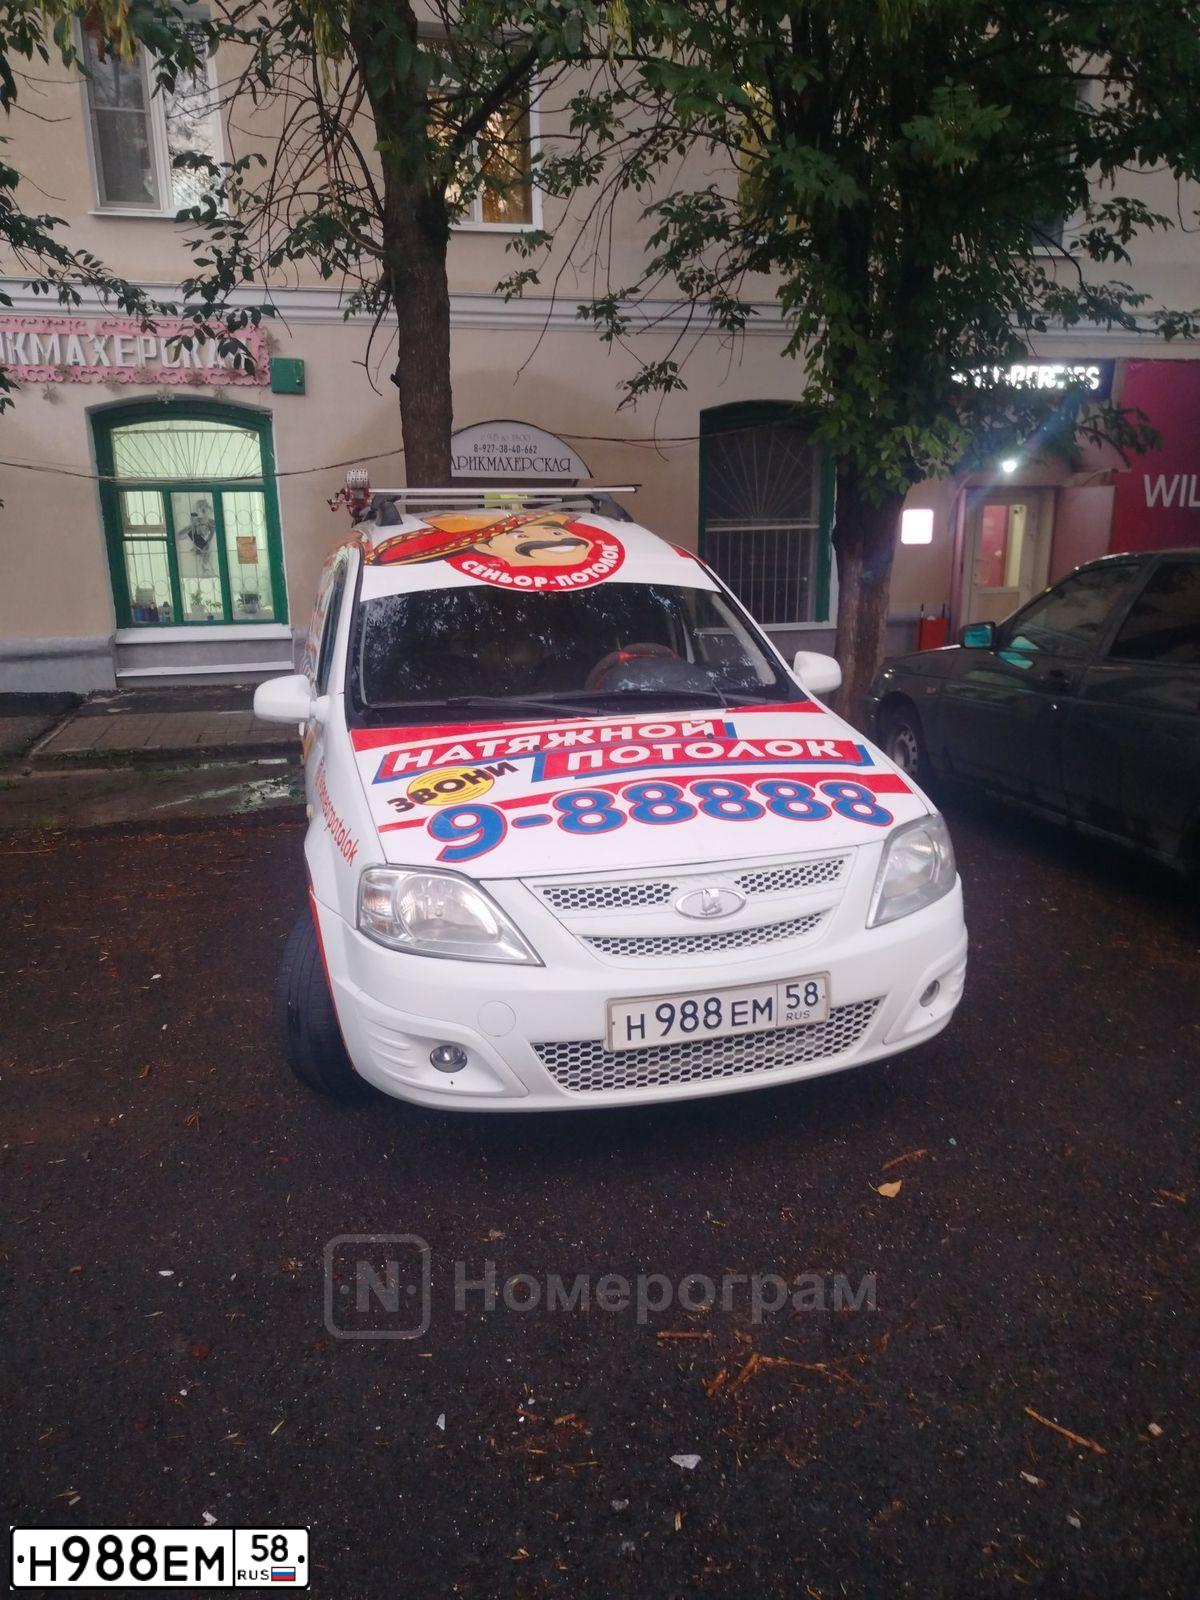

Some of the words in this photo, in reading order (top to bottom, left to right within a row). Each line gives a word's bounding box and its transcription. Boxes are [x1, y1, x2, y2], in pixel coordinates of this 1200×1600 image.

[473, 444, 537, 454] 8-927-38-40-662
[1143, 474, 1200, 507] WIL
[392, 719, 716, 772] НАТЯЖНОЙ
[567, 740, 843, 771] ПОТОЛОК
[387, 761, 519, 813] ЗВОНИ
[426, 778, 894, 864] 9-88888
[785, 981, 819, 1009] 58
[785, 1009, 811, 1021] RUS
